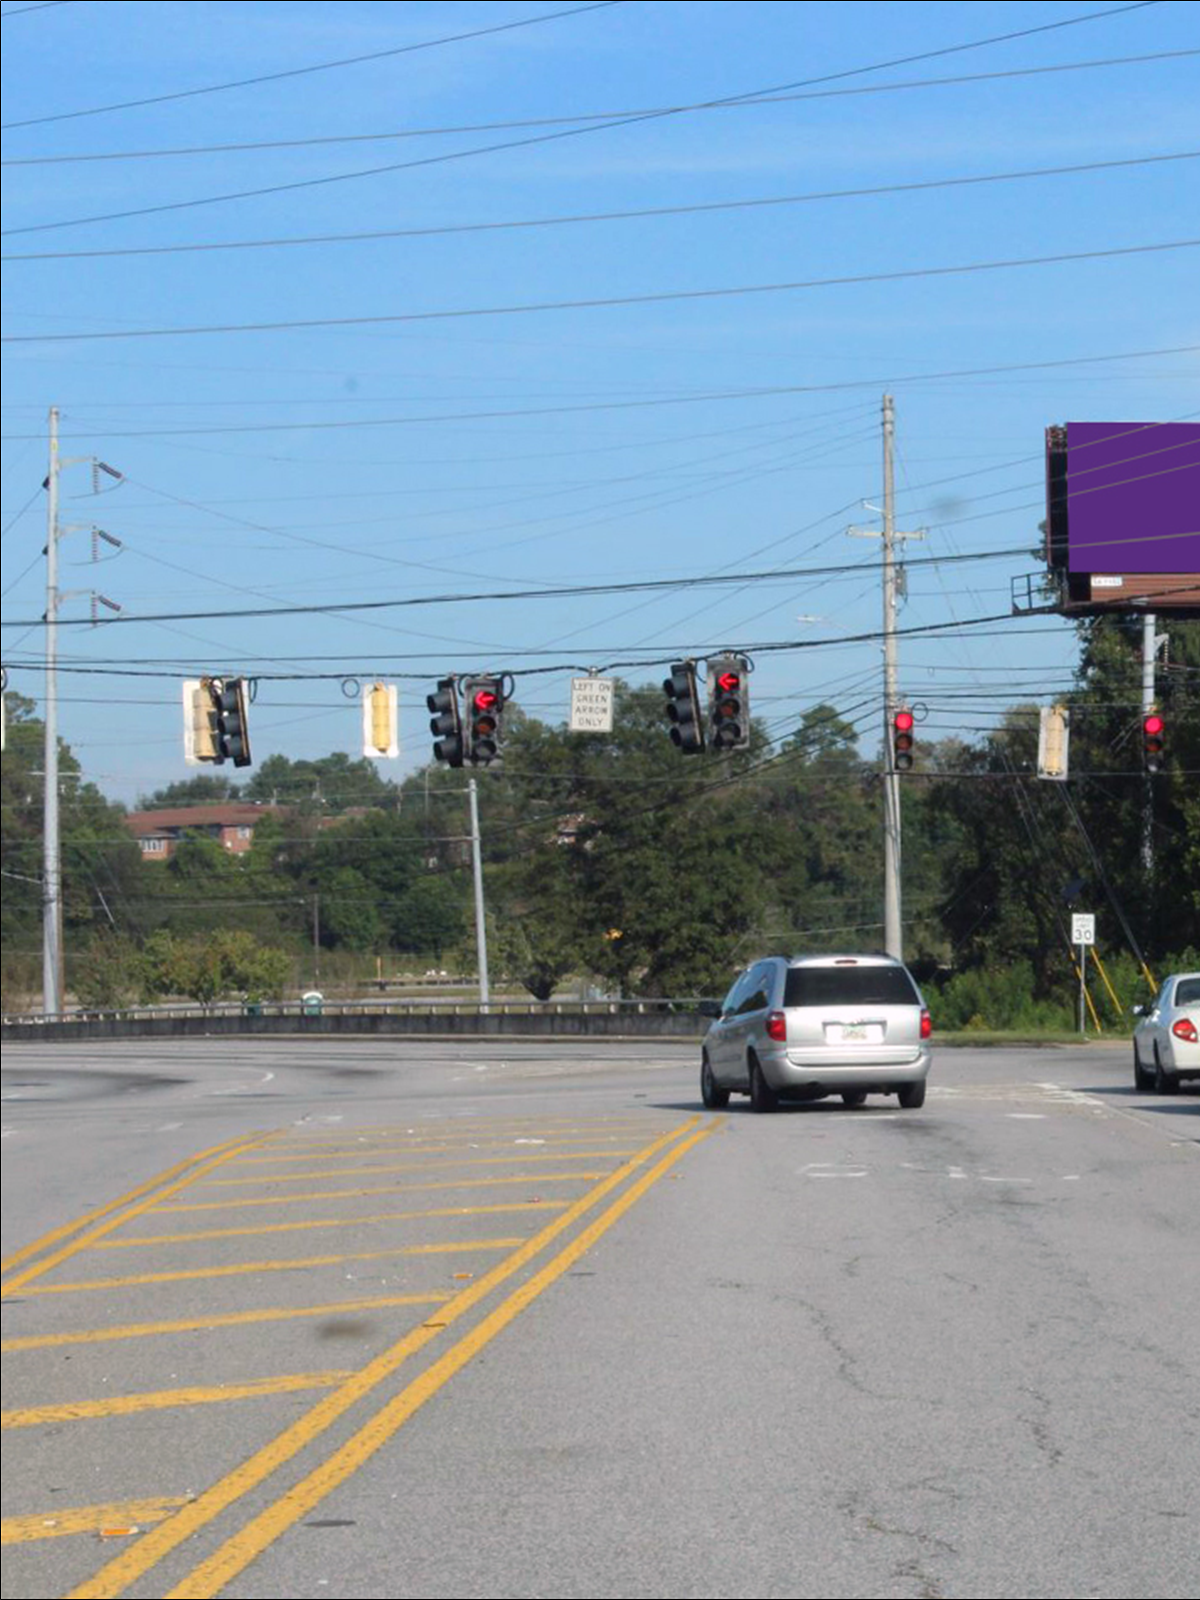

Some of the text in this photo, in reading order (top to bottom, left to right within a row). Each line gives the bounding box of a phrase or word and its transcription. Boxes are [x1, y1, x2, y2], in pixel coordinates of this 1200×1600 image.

[574, 682, 610, 691] LEFT ON
[577, 694, 607, 703] GREEN
[575, 705, 607, 714] ARROW
[578, 717, 603, 726] ONLY
[1075, 929, 1091, 940] 30
